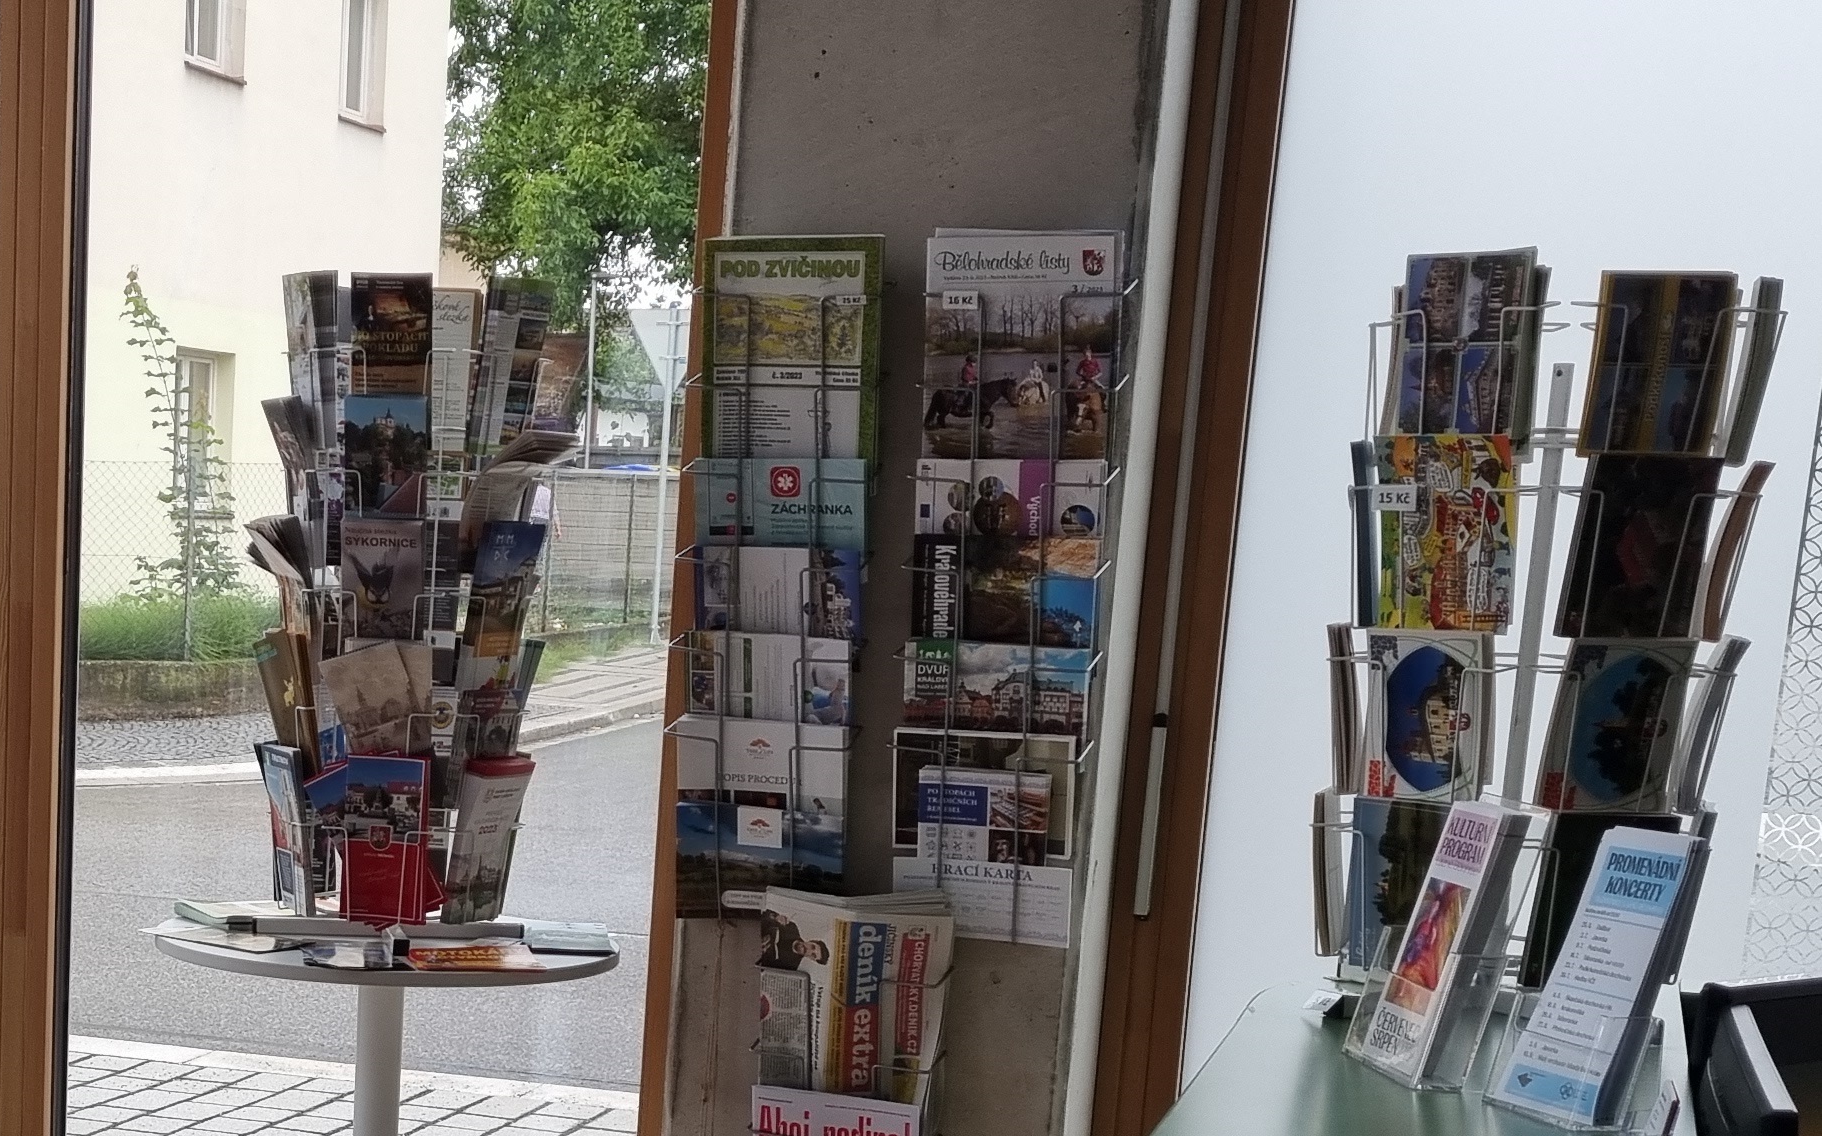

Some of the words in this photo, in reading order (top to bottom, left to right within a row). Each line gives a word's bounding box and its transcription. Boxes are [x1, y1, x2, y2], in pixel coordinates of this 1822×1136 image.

[720, 260, 760, 278] POD
[764, 256, 861, 278] ZVIČINOU
[934, 251, 1034, 272] Bělohradské
[1040, 250, 1071, 274] listy
[962, 295, 973, 305] Kč
[771, 501, 853, 516] ZÁCHRANKA
[1378, 491, 1393, 504] 15
[1396, 490, 1411, 504] Kč
[344, 536, 418, 549] SÝKORNICE
[932, 545, 957, 639] Kráovéhrade
[718, 773, 745, 783] OPIS
[1448, 815, 1496, 844] KULTURNÍ
[1440, 839, 1487, 864] PROGRAM
[1607, 852, 1682, 883] PROMENÁDNÍ
[1603, 875, 1666, 903] KONCERTY
[855, 924, 882, 1004] deník
[850, 1007, 875, 1088] extra
